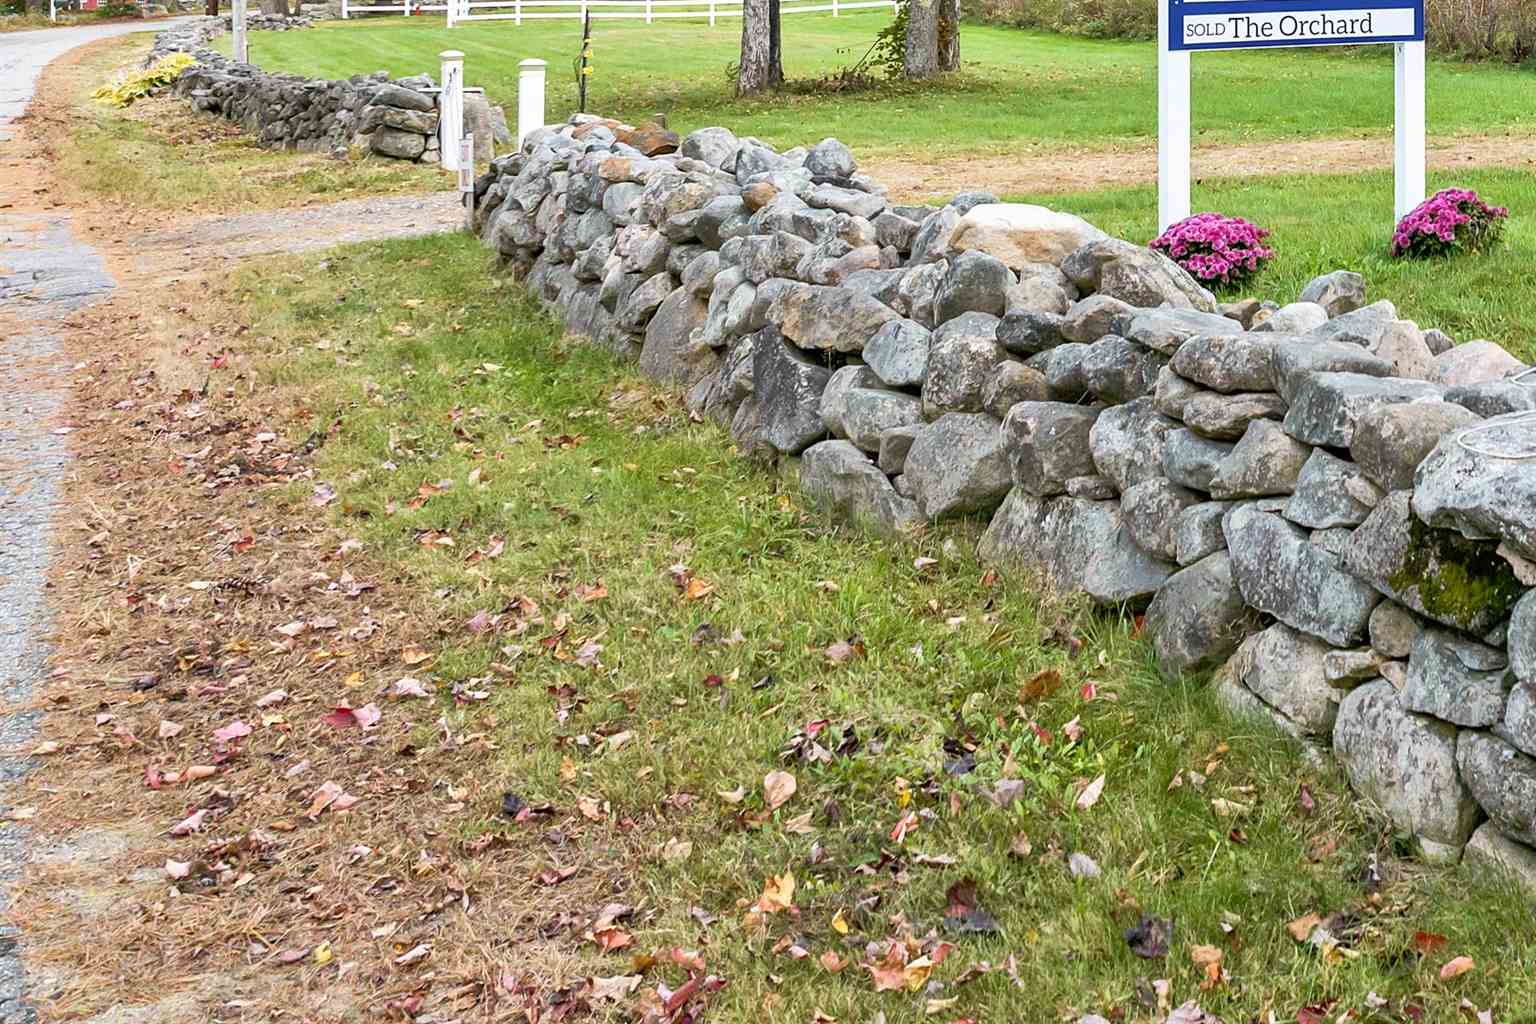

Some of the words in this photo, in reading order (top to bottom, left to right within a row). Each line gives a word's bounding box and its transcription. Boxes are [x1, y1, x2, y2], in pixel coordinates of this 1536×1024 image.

[1186, 23, 1226, 37] SOLD
[1228, 16, 1273, 39] The
[1279, 12, 1373, 36] Orchard
